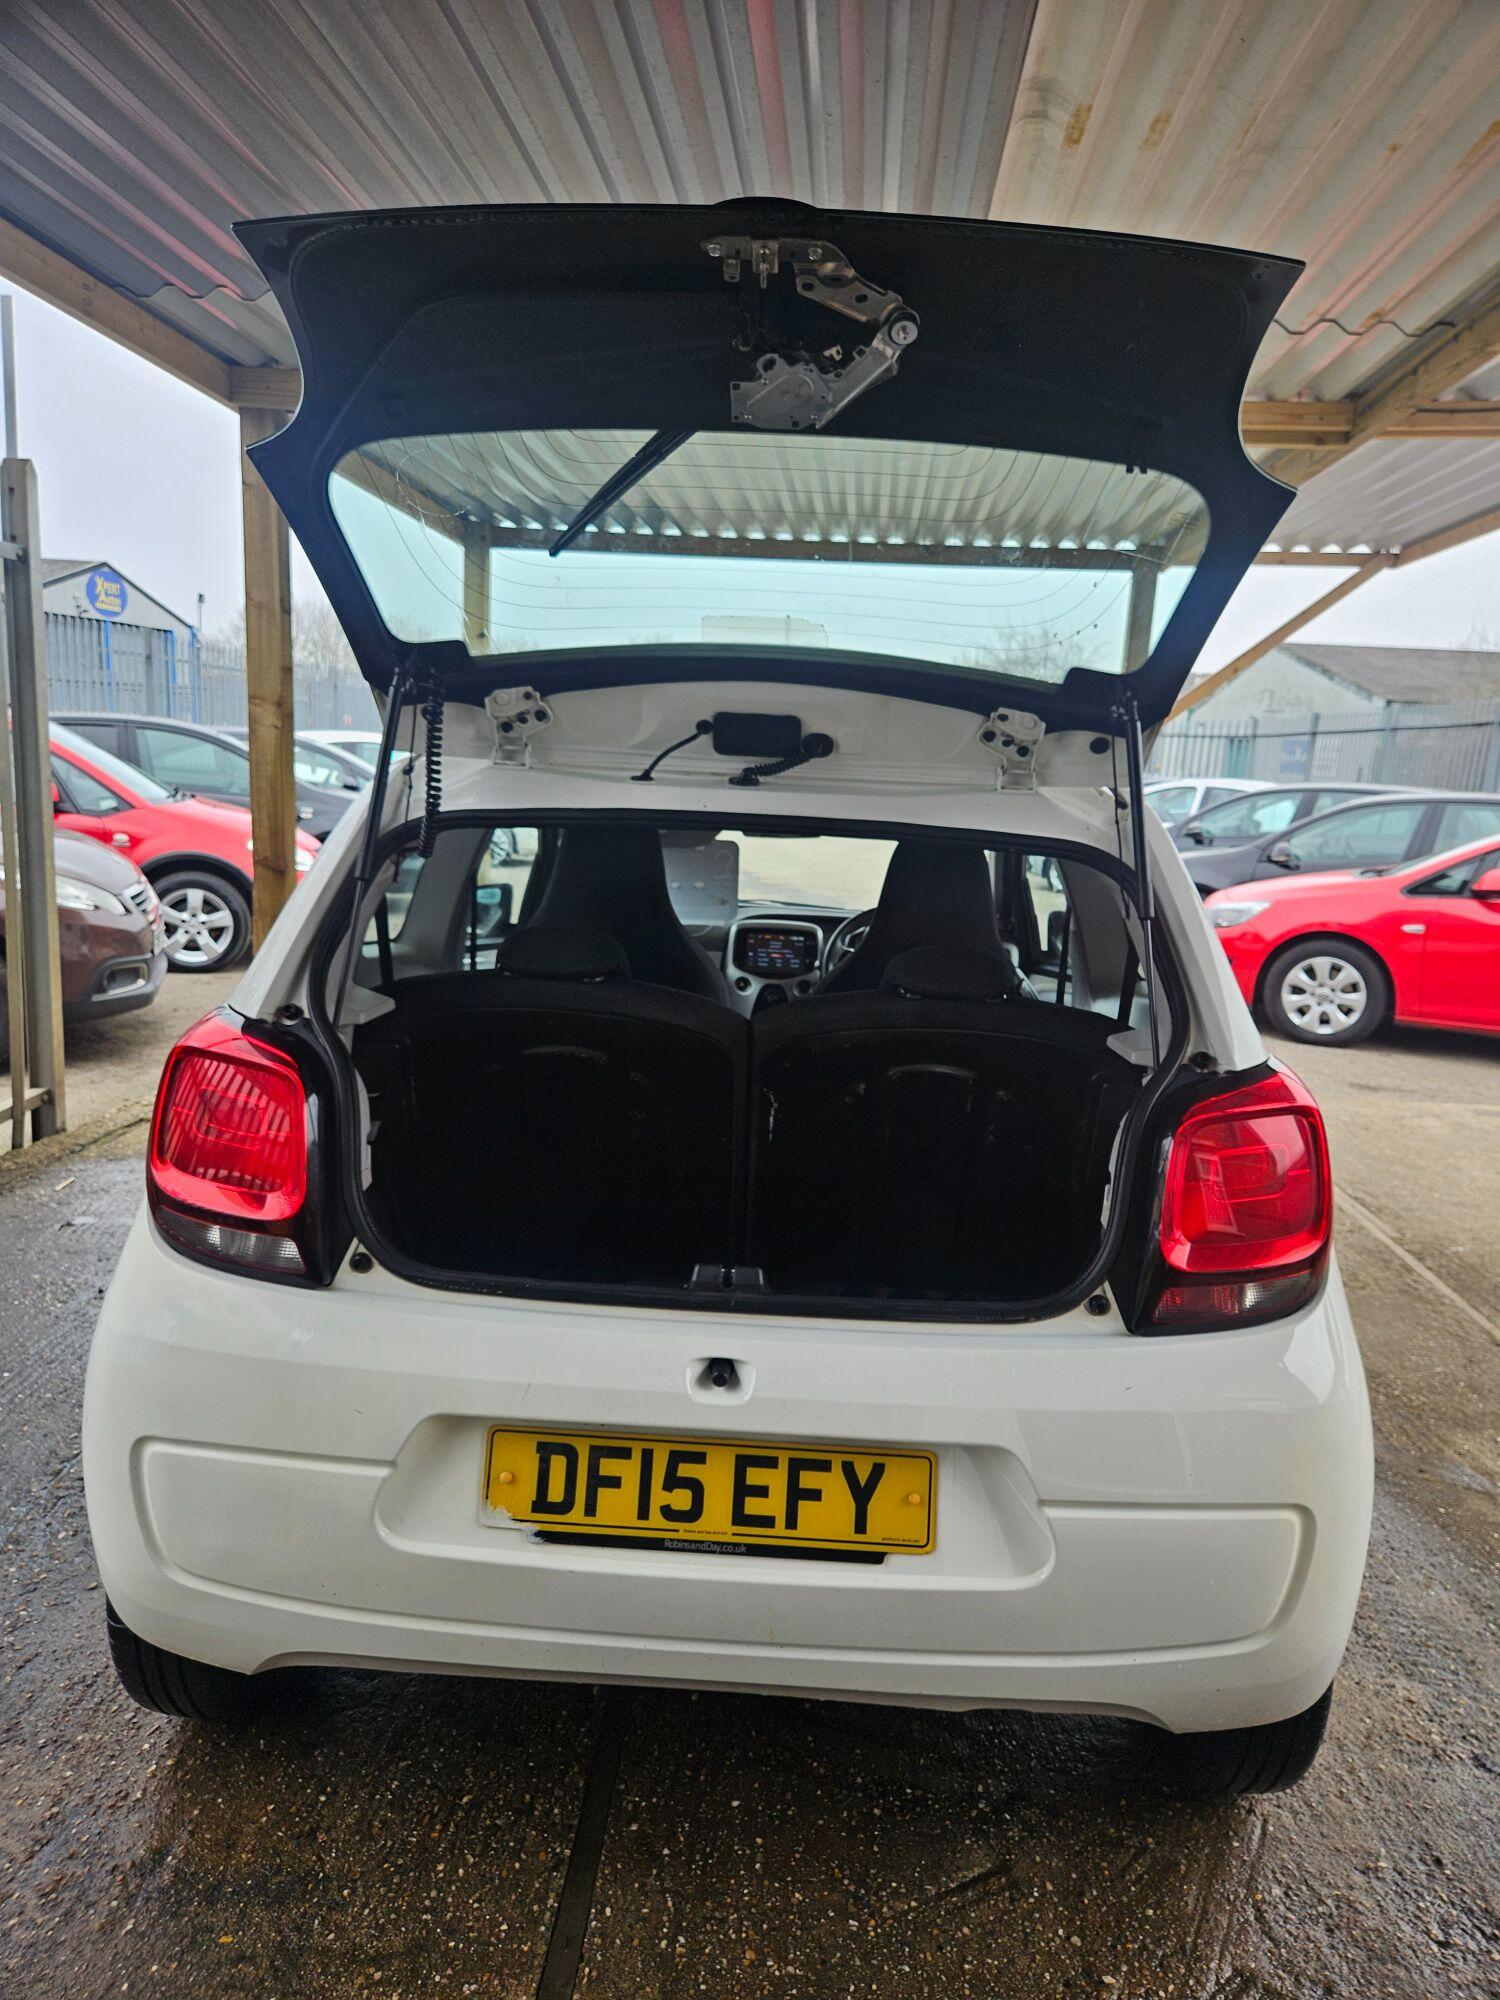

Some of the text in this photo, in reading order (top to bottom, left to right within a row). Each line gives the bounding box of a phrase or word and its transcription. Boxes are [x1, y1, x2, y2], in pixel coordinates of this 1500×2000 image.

[531, 1441, 886, 1535] DF15 EFY
[664, 1539, 747, 1554] RobinsandDay.co.uk
